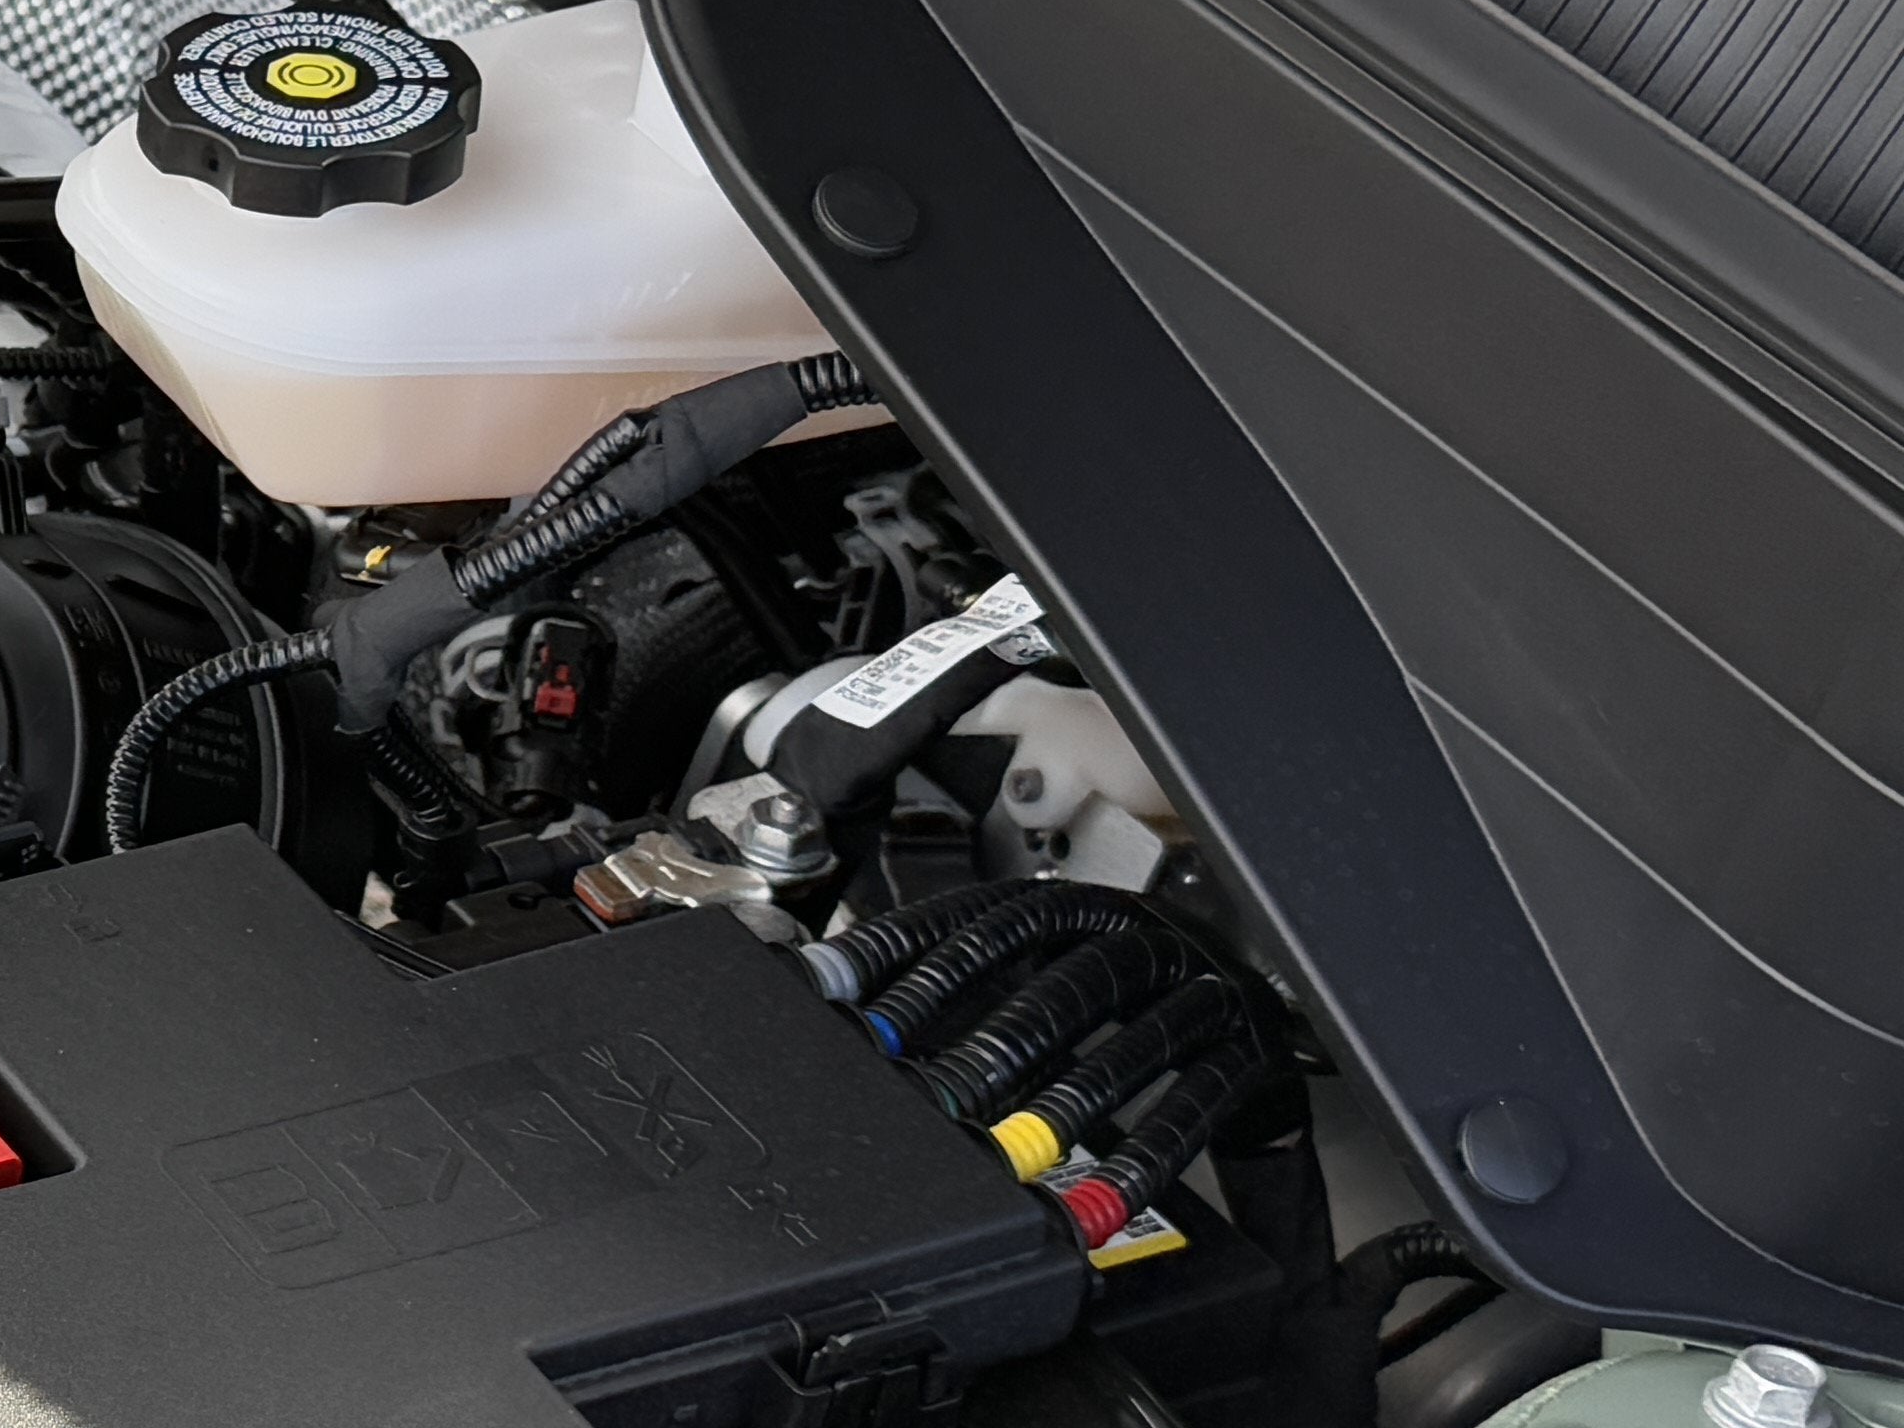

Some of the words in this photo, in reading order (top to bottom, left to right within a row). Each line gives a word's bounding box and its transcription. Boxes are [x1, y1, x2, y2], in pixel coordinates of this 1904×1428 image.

[246, 10, 318, 29] SEALED
[334, 13, 390, 34] FROM
[271, 34, 336, 49] CLEAN
[349, 29, 410, 61] BEFORE
[380, 26, 430, 54] FLUID
[201, 40, 239, 65] ONLY
[227, 38, 277, 67] FILLER
[420, 56, 448, 77] DOT
[226, 121, 303, 146] BOUCHON
[251, 114, 310, 133] LIQUIDE
